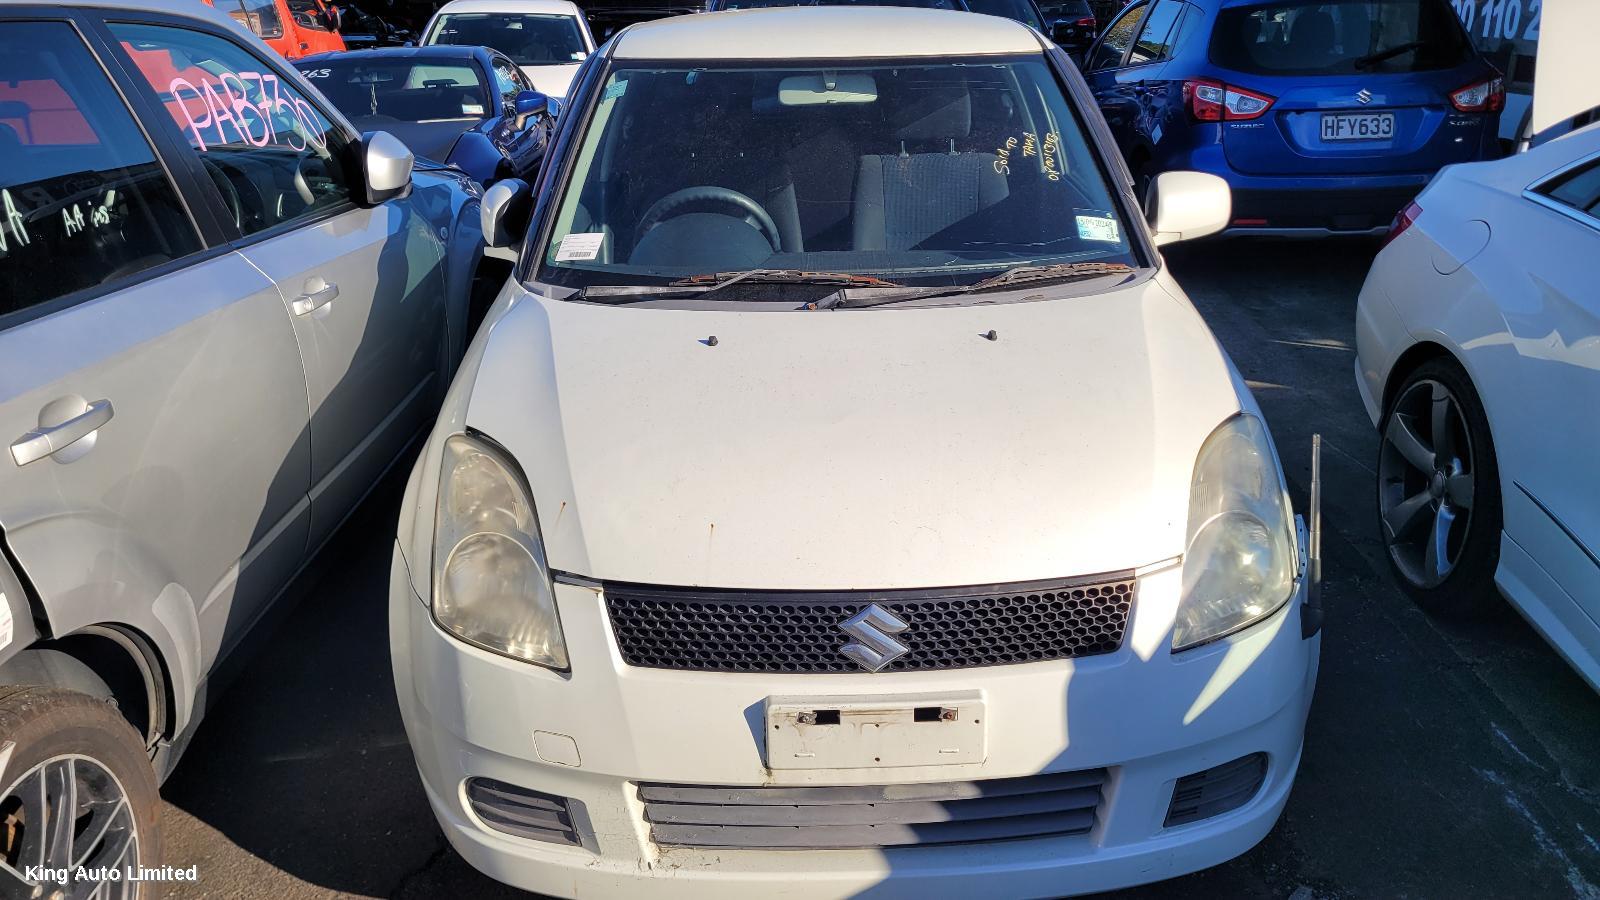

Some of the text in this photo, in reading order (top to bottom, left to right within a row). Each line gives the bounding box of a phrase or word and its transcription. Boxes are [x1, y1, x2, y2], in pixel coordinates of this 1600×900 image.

[1481, 0, 1521, 39] 110
[1324, 118, 1392, 137] HFY633
[993, 148, 1010, 175] Sold
